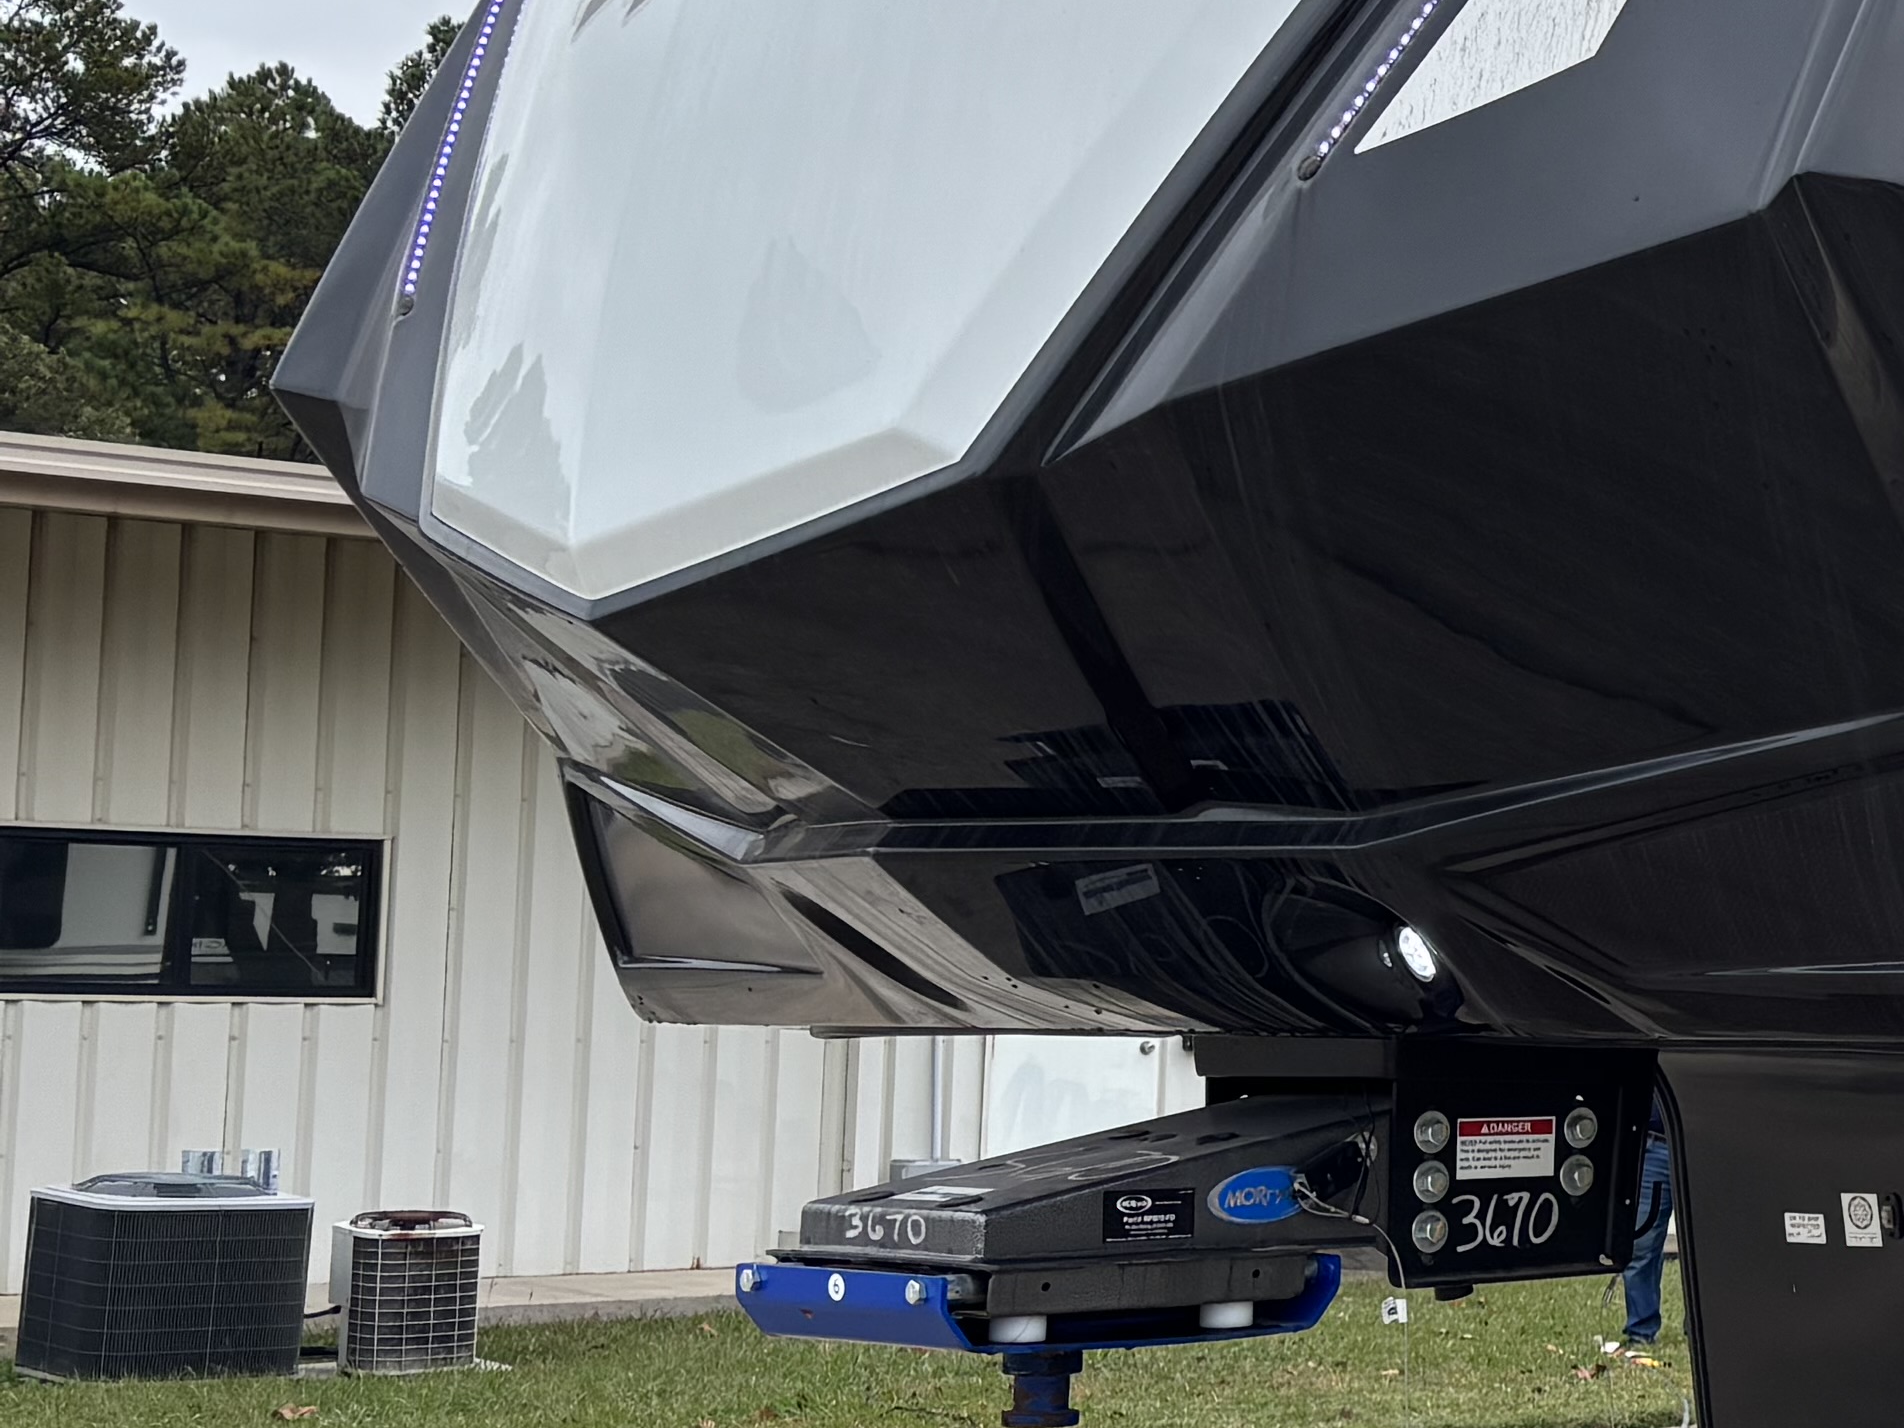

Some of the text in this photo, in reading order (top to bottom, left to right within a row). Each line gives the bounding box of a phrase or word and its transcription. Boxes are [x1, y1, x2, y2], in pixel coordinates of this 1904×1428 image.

[1489, 1121, 1532, 1133] DANGER
[845, 1208, 926, 1245] 3670
[1451, 1191, 1559, 1252] 3670
